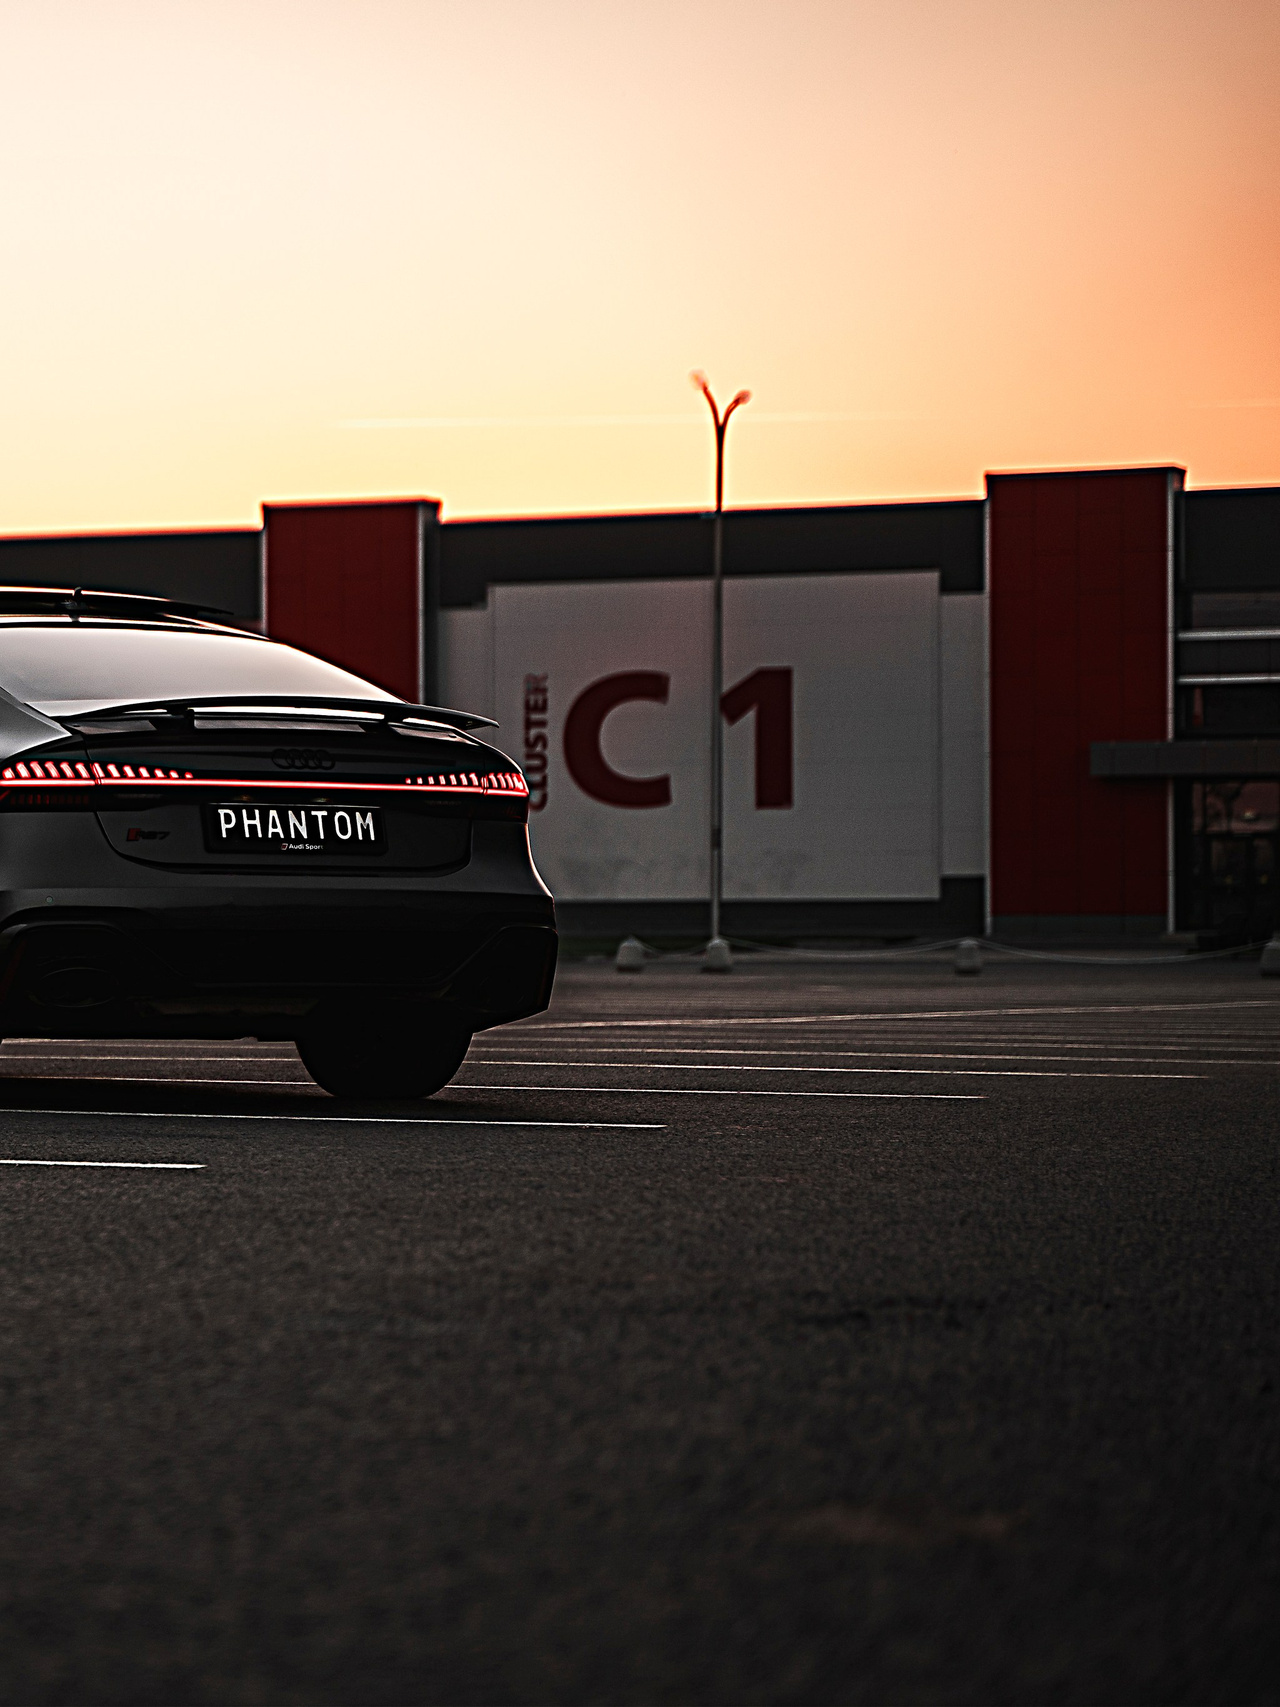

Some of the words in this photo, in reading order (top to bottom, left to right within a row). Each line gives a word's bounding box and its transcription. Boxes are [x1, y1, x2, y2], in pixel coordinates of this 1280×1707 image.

[524, 673, 548, 811] CLUSTER
[218, 809, 375, 841] PHANTOM
[305, 843, 324, 851] Sport
